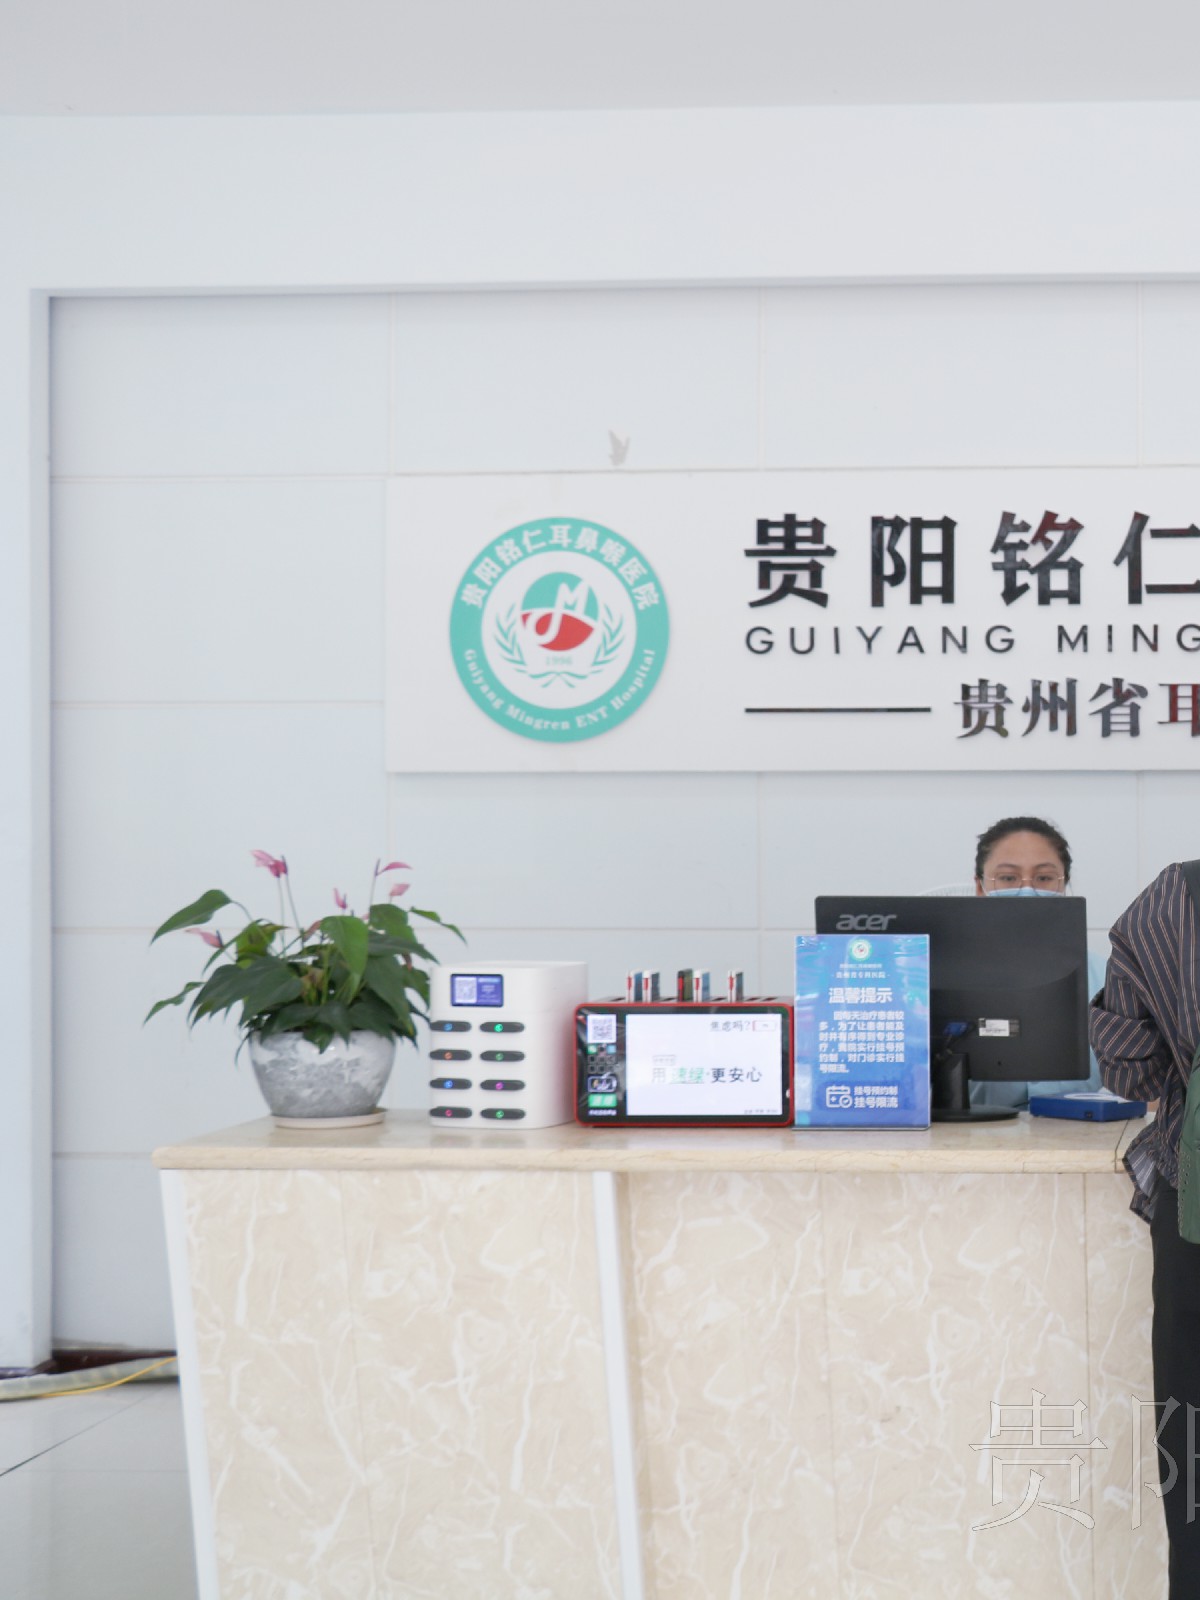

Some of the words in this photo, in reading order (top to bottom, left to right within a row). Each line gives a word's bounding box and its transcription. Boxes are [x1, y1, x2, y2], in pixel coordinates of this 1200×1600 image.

[461, 524, 660, 611] 贵阳铭仁耳鼻喉医院
[745, 625, 1015, 655] GUIYANG
[463, 648, 505, 710] Guiyang
[505, 704, 571, 731] Mingren
[575, 705, 609, 729] ENT
[610, 648, 656, 711] Hospital
[836, 914, 897, 931] acer
[828, 987, 893, 1004] 温馨提示
[853, 1096, 898, 1109] 挂号限流
